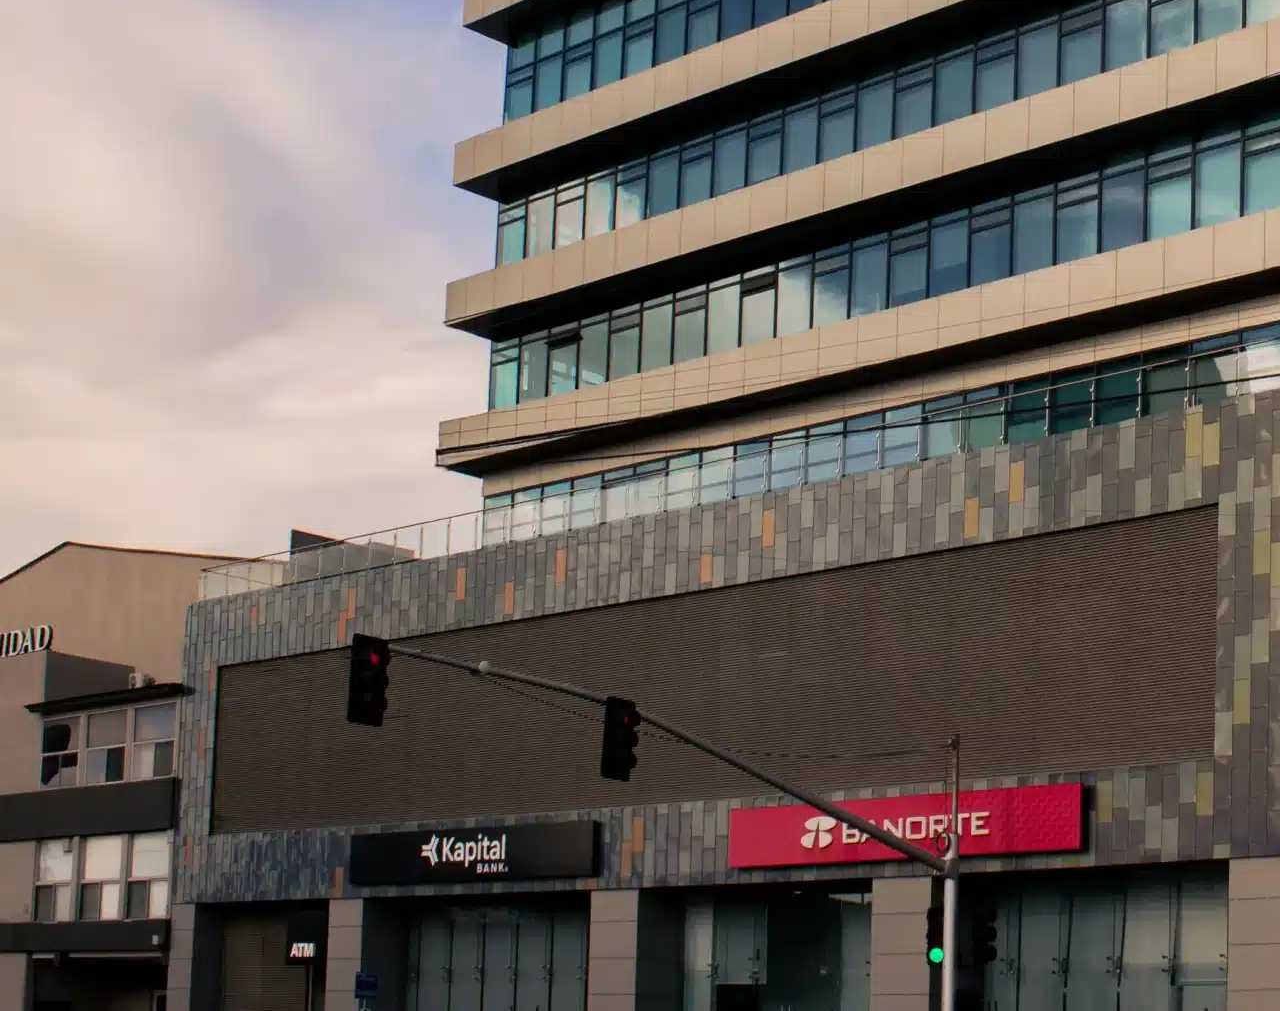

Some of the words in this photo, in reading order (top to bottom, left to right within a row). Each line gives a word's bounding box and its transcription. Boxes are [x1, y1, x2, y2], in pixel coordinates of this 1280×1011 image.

[0, 625, 50, 657] IDAD
[441, 832, 507, 868] Kapital
[476, 862, 506, 874] BANK
[289, 941, 316, 958] ATM
